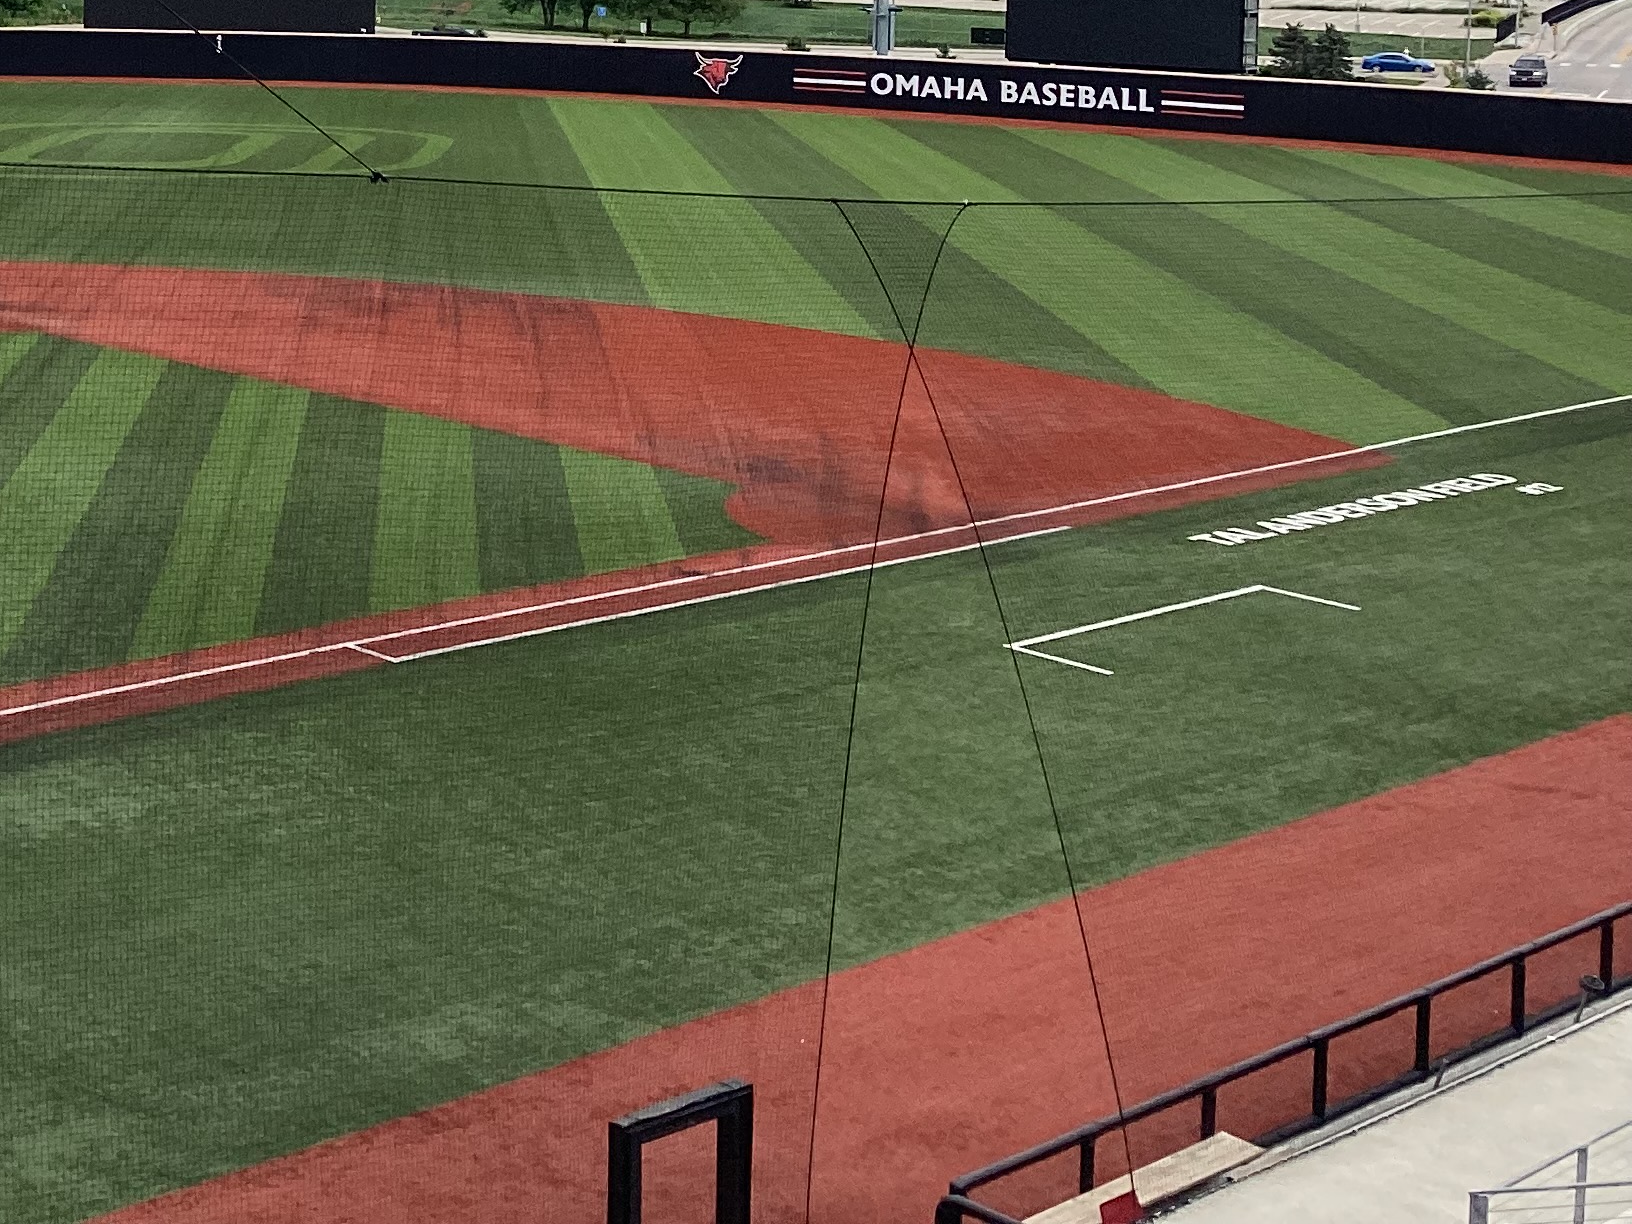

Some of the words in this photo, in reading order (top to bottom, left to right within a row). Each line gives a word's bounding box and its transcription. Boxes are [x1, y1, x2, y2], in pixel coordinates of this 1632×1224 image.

[870, 72, 988, 102] OMAHA
[999, 79, 1155, 113] BASEBALL
[1186, 527, 1280, 546] TAL
[1255, 486, 1448, 535] ANDERSON
[1418, 472, 1519, 497] FIELD
